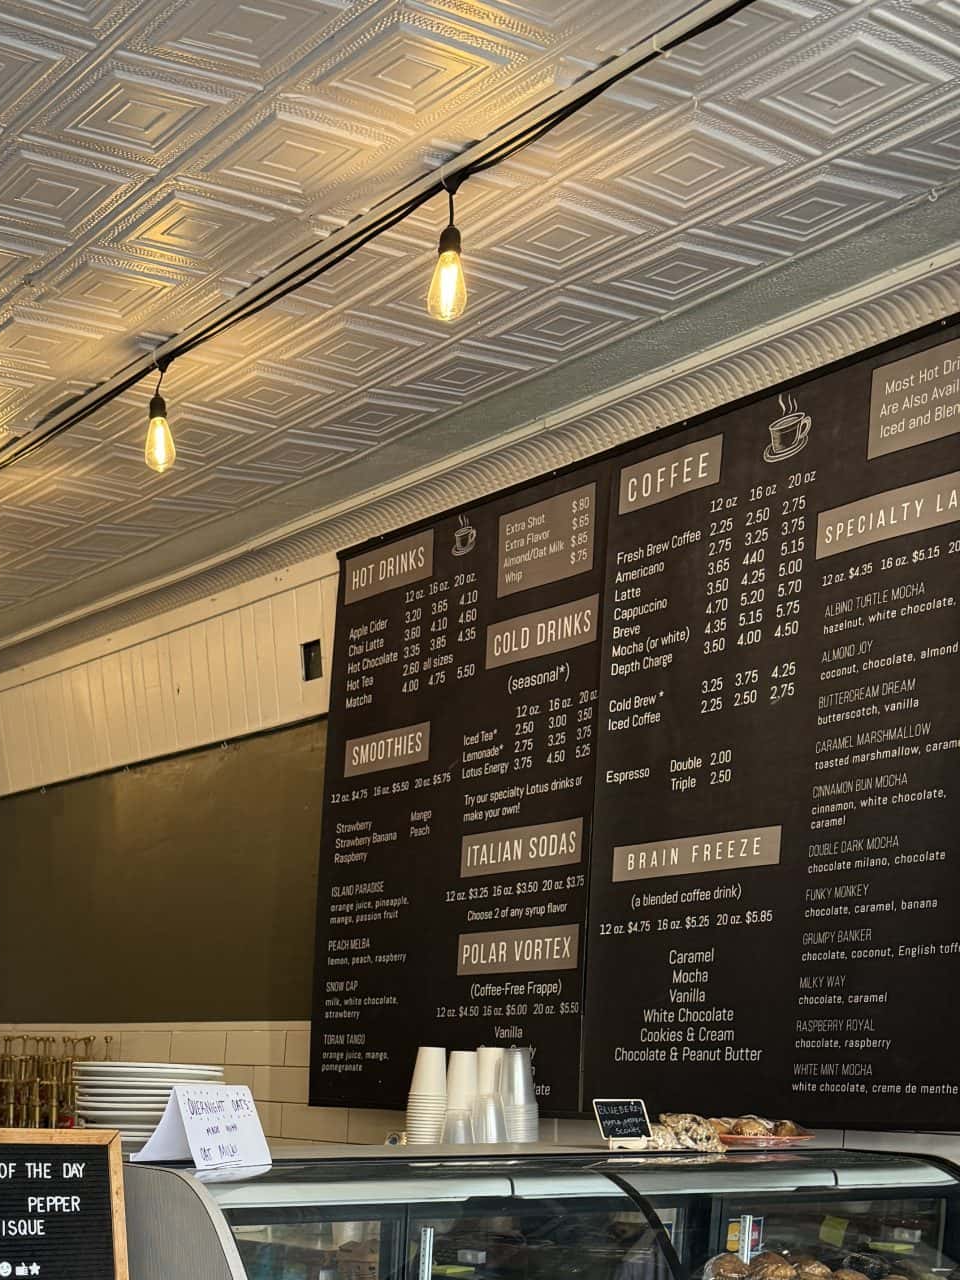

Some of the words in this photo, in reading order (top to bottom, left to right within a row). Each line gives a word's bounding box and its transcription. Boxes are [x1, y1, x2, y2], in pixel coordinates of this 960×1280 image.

[628, 452, 709, 502] COFFEE
[710, 498, 723, 513] 12
[725, 497, 738, 508] oz
[749, 486, 762, 501] 16
[765, 484, 777, 496] oz
[788, 472, 801, 488] 20
[804, 471, 816, 483] oz
[617, 547, 644, 565] Fresh
[647, 541, 670, 557] Brew
[671, 530, 701, 548] Coffee
[709, 517, 733, 536] 2.25
[745, 507, 770, 526] 2.50
[782, 495, 806, 515] 2.75
[825, 498, 924, 543] SPECIALTY
[615, 562, 664, 584] Americano
[708, 537, 732, 556] 2.75
[744, 527, 768, 546] 3.25
[781, 516, 805, 536] 3.75
[352, 564, 375, 590] HOT
[379, 546, 424, 580] DRINKS
[614, 598, 667, 621] Cappuccino
[706, 577, 728, 596] 3.50
[741, 568, 765, 586] 4.25
[778, 558, 802, 576] 5.00
[613, 624, 640, 639] Breve
[705, 597, 728, 614] 4.70
[740, 588, 765, 606] 5.20
[778, 579, 802, 597] 5.70
[494, 627, 530, 656] COLD
[537, 610, 592, 645] DRINKS
[612, 641, 644, 657] Mocha
[646, 636, 659, 653] (or
[661, 626, 690, 645] white)
[704, 618, 727, 634] 4.35
[739, 609, 763, 626] 5.15
[776, 600, 800, 618] 5.75
[610, 660, 640, 676] Depth
[643, 653, 673, 670] Charge
[703, 637, 725, 654] 3.50
[737, 629, 761, 646] 4.00
[774, 620, 799, 638] 4.50
[608, 714, 630, 731] Iced
[632, 711, 661, 727] Coffee
[700, 697, 723, 713] 2.25
[733, 689, 757, 707] 2.50
[770, 682, 795, 700] 2.75
[352, 732, 423, 766] SMOOTHIES
[606, 767, 650, 784] Espresso
[670, 756, 702, 772] Double
[710, 749, 732, 766] 2.00
[671, 776, 696, 792] Triple
[710, 769, 731, 785] 2.50
[467, 839, 522, 867] ITALIAN
[528, 831, 576, 859] SODAS
[627, 848, 679, 871] BRAIN
[692, 837, 761, 863] FREEZE
[631, 894, 641, 910] (a
[643, 891, 678, 907] blended
[680, 888, 711, 903] coffee
[713, 882, 742, 900] drink)
[805, 887, 832, 901] FUNKY
[834, 883, 870, 898] MONKEY
[467, 910, 493, 921] Choose
[494, 908, 499, 919] 2
[501, 906, 508, 918] of
[510, 907, 524, 919] any
[525, 905, 545, 918] syrup
[547, 902, 568, 913] flavor
[600, 924, 612, 935] 12
[628, 920, 651, 934] $4.75
[657, 918, 668, 931] 16
[685, 915, 710, 930] $5.25
[716, 913, 728, 926] 20
[746, 910, 773, 924] $5.85
[804, 906, 851, 918] chocolate,
[854, 901, 897, 914] caramel,
[901, 899, 938, 910] banana
[462, 942, 507, 965] POLAR
[514, 936, 571, 961] VORTEX
[669, 948, 714, 964] Caramel
[470, 982, 525, 999] (Coffee-Free
[527, 978, 562, 996] Frappe)
[672, 968, 708, 983] Mocha
[669, 988, 706, 1003] Vanilla
[643, 1008, 675, 1023] White
[678, 1006, 734, 1022] Chocolate
[640, 1027, 683, 1042] Cookies
[686, 1026, 695, 1041] &
[698, 1026, 735, 1041] Cream
[614, 1047, 666, 1061] Chocolate
[670, 1047, 678, 1061] &
[682, 1046, 721, 1061] Peanut
[725, 1046, 763, 1061] Butter
[792, 1081, 817, 1092] white
[819, 1082, 868, 1094] chocolate,
[872, 1084, 901, 1094] creme
[905, 1082, 917, 1094] de
[920, 1083, 959, 1094] menthe
[25, 1162, 52, 1179] THE
[62, 1162, 86, 1179] DAY
[28, 1195, 81, 1213] PEPPER
